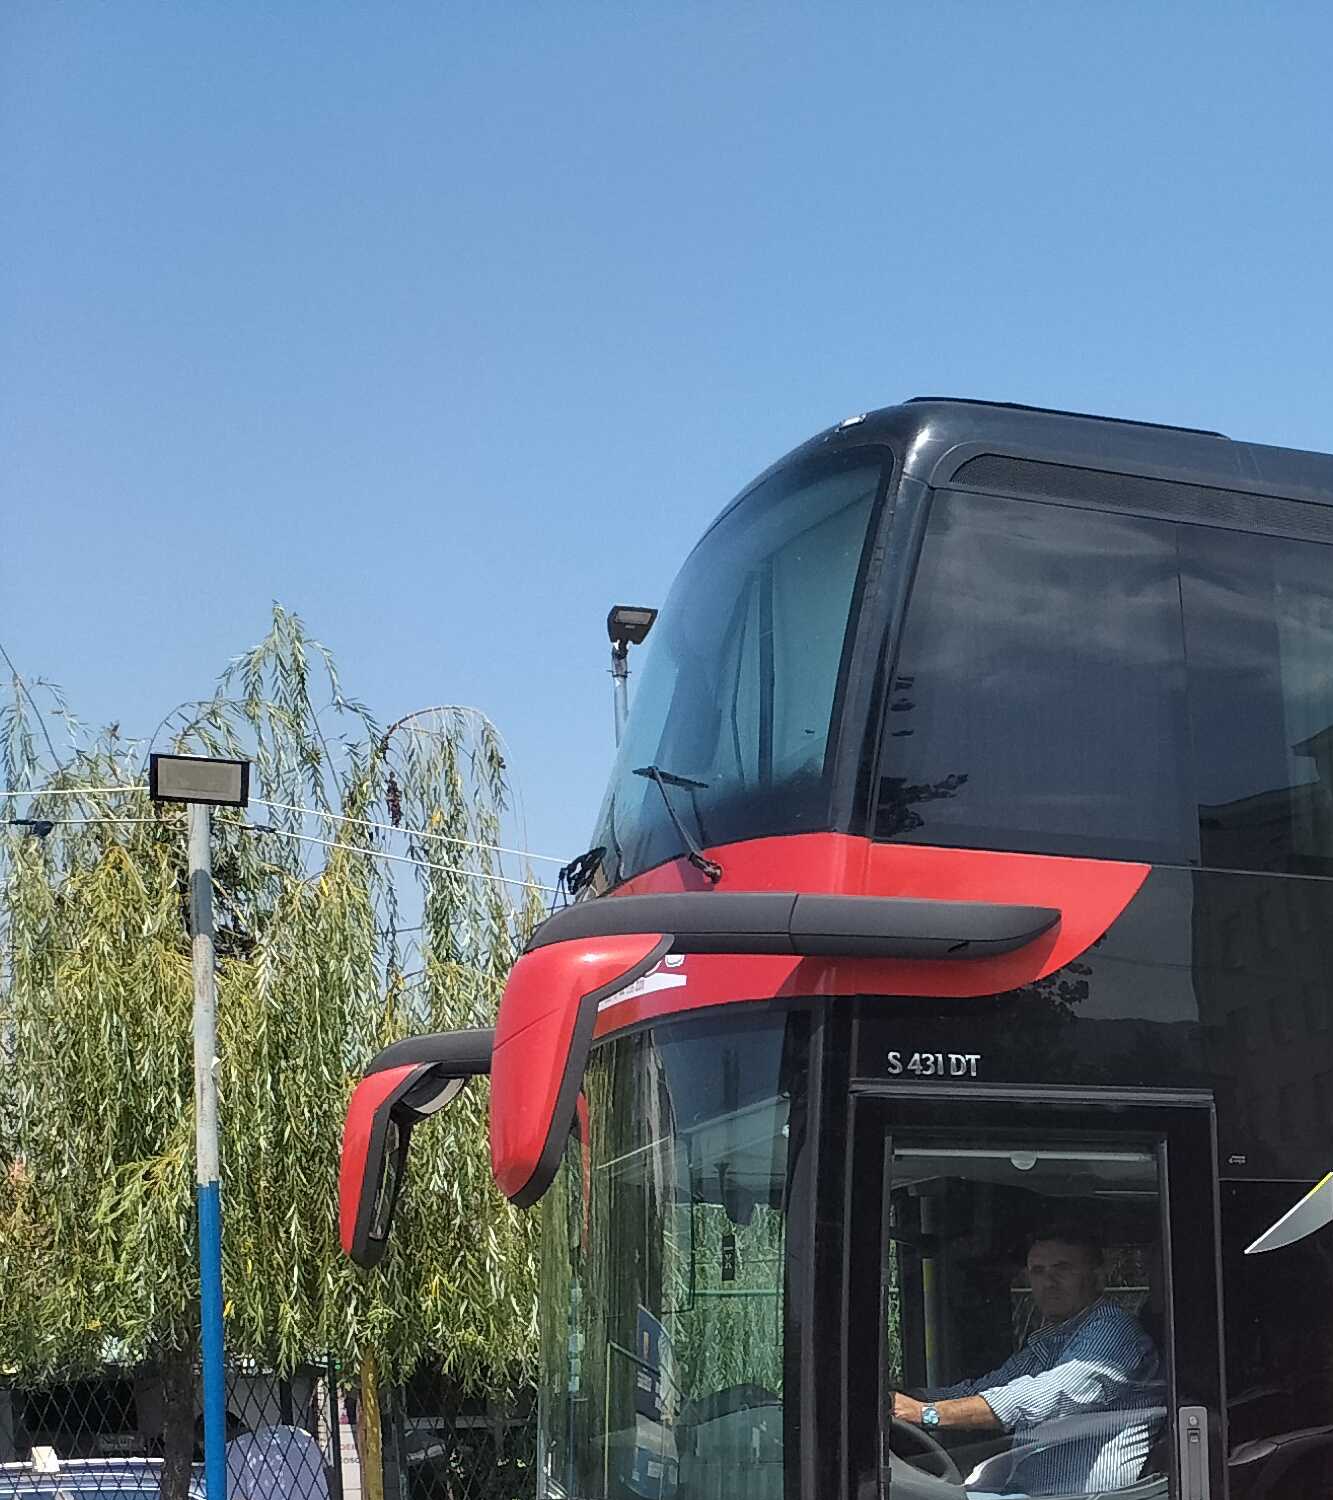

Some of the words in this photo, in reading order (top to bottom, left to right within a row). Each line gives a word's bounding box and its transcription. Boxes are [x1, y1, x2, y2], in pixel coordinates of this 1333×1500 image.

[887, 1051, 903, 1074] S
[907, 1053, 945, 1075] 431
[948, 1053, 981, 1076] DT
